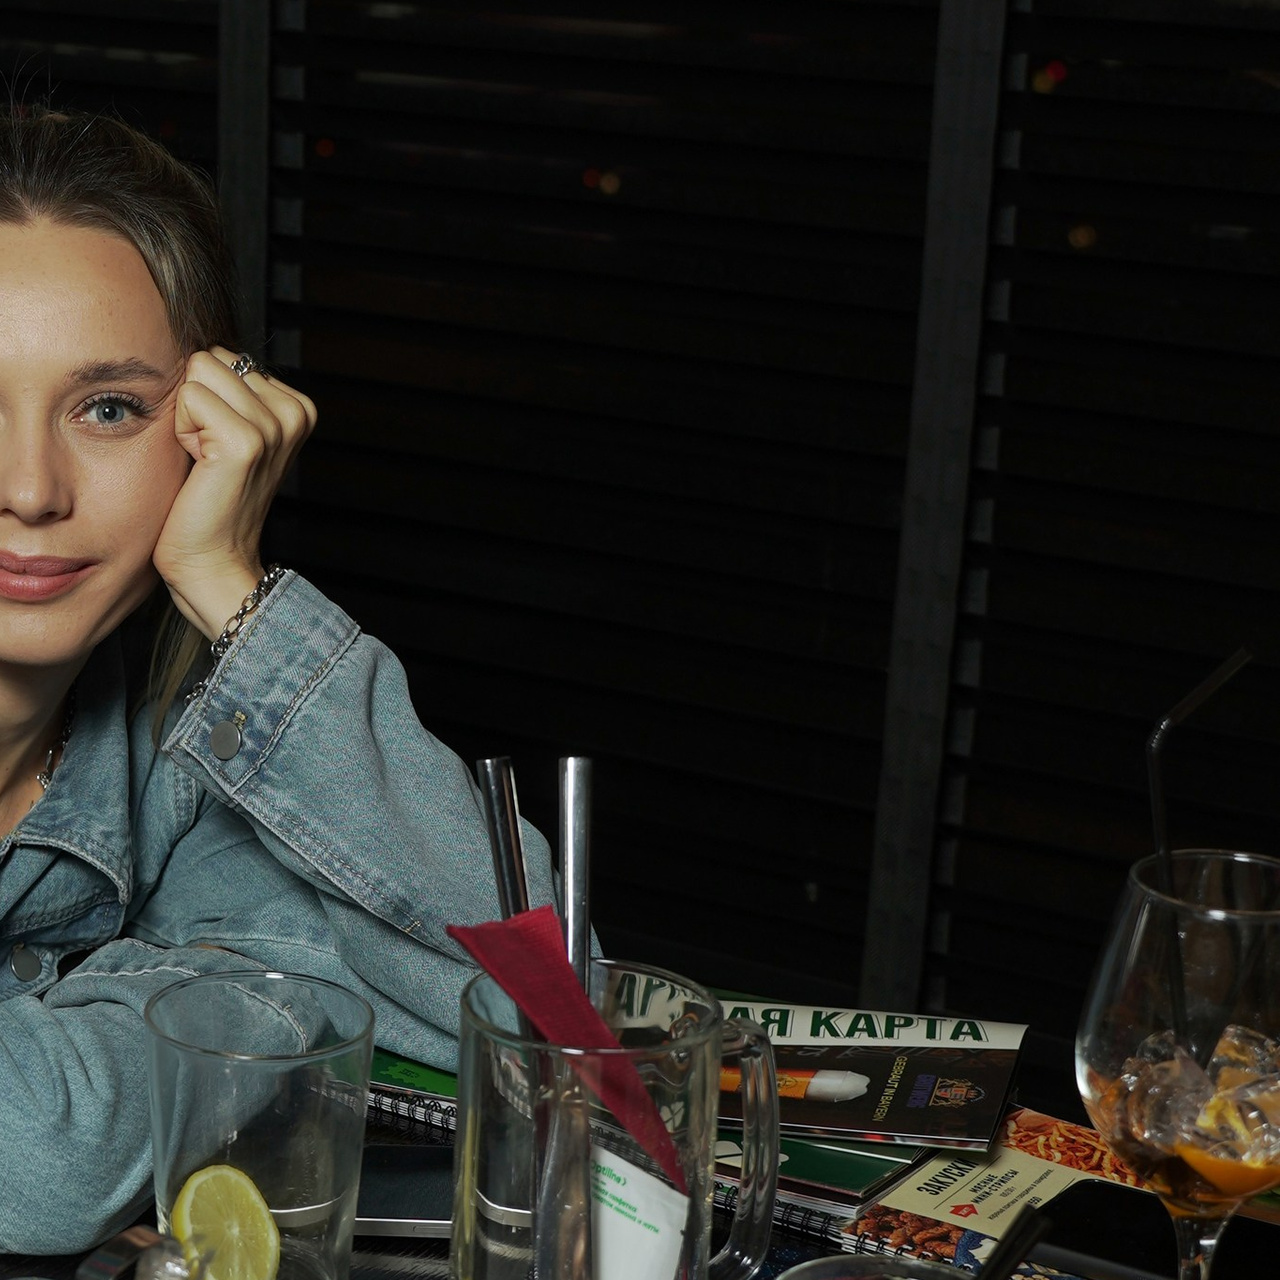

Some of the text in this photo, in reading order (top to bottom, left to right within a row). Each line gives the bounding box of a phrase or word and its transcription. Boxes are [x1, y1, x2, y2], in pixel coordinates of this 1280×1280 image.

[809, 1009, 989, 1043] КАРТА
[871, 1055, 908, 1122] GEBRAUT IN BAYERN
[916, 1158, 980, 1197] ЗАКУСКИ
[969, 1173, 999, 1195] МЯСНЫЕ
[970, 1168, 1019, 1204] МИНИ-СТРИПСЫ
